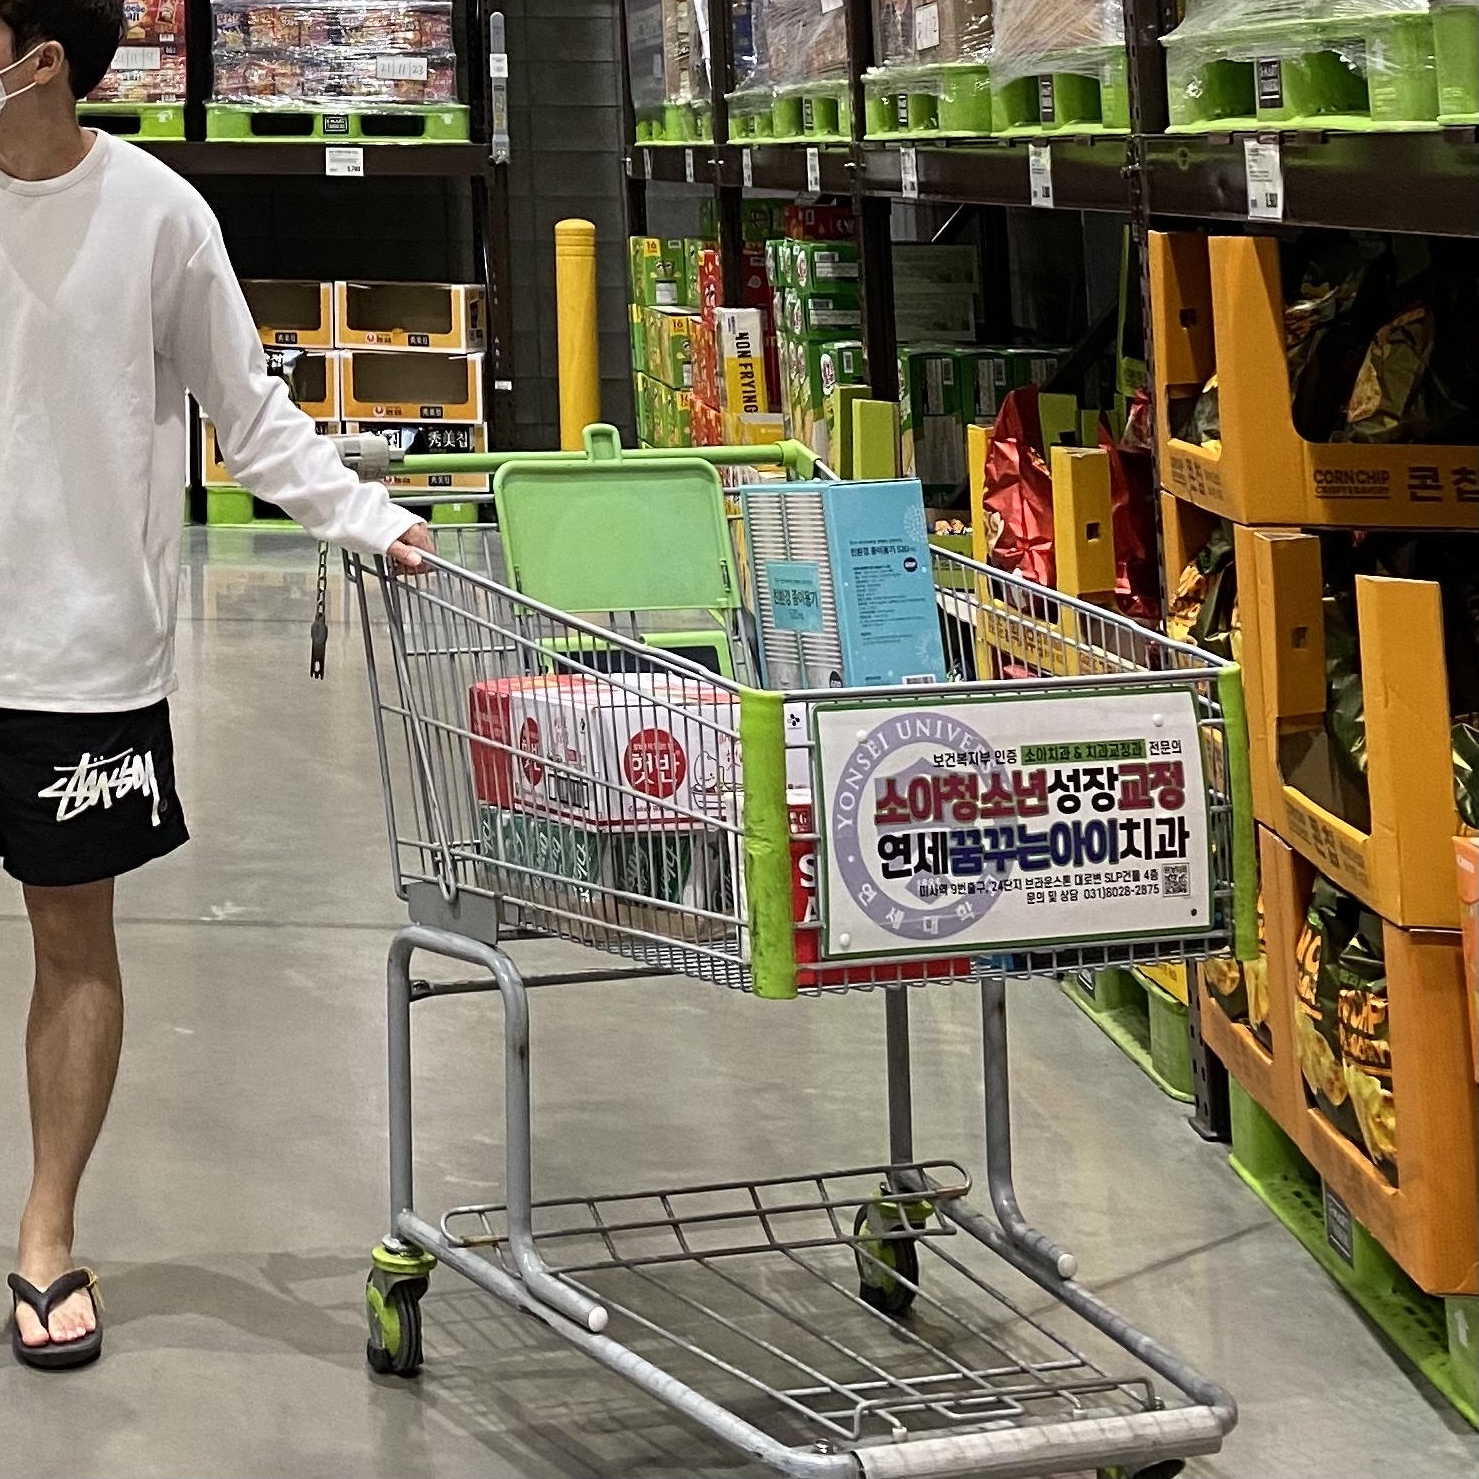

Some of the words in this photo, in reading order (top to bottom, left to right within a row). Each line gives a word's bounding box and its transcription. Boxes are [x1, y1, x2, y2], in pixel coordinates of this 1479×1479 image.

[646, 241, 657, 249] 16
[735, 332, 751, 359] NON
[739, 362, 759, 414] FRYING
[1313, 470, 1353, 485] CORN
[1354, 471, 1390, 485] CHIP
[934, 750, 990, 767] 보건복지부
[995, 749, 1017, 765] 인증
[1149, 740, 1182, 756] 전문의
[632, 753, 680, 785] 햇반
[837, 733, 890, 830] YONSEI
[877, 816, 1190, 879] 연세꿈꾸는아이치과
[1027, 891, 1045, 904] 문의
[1048, 890, 1058, 903] 및
[1061, 889, 1079, 902] 상담
[1083, 884, 1160, 900] 031)8028-2875
